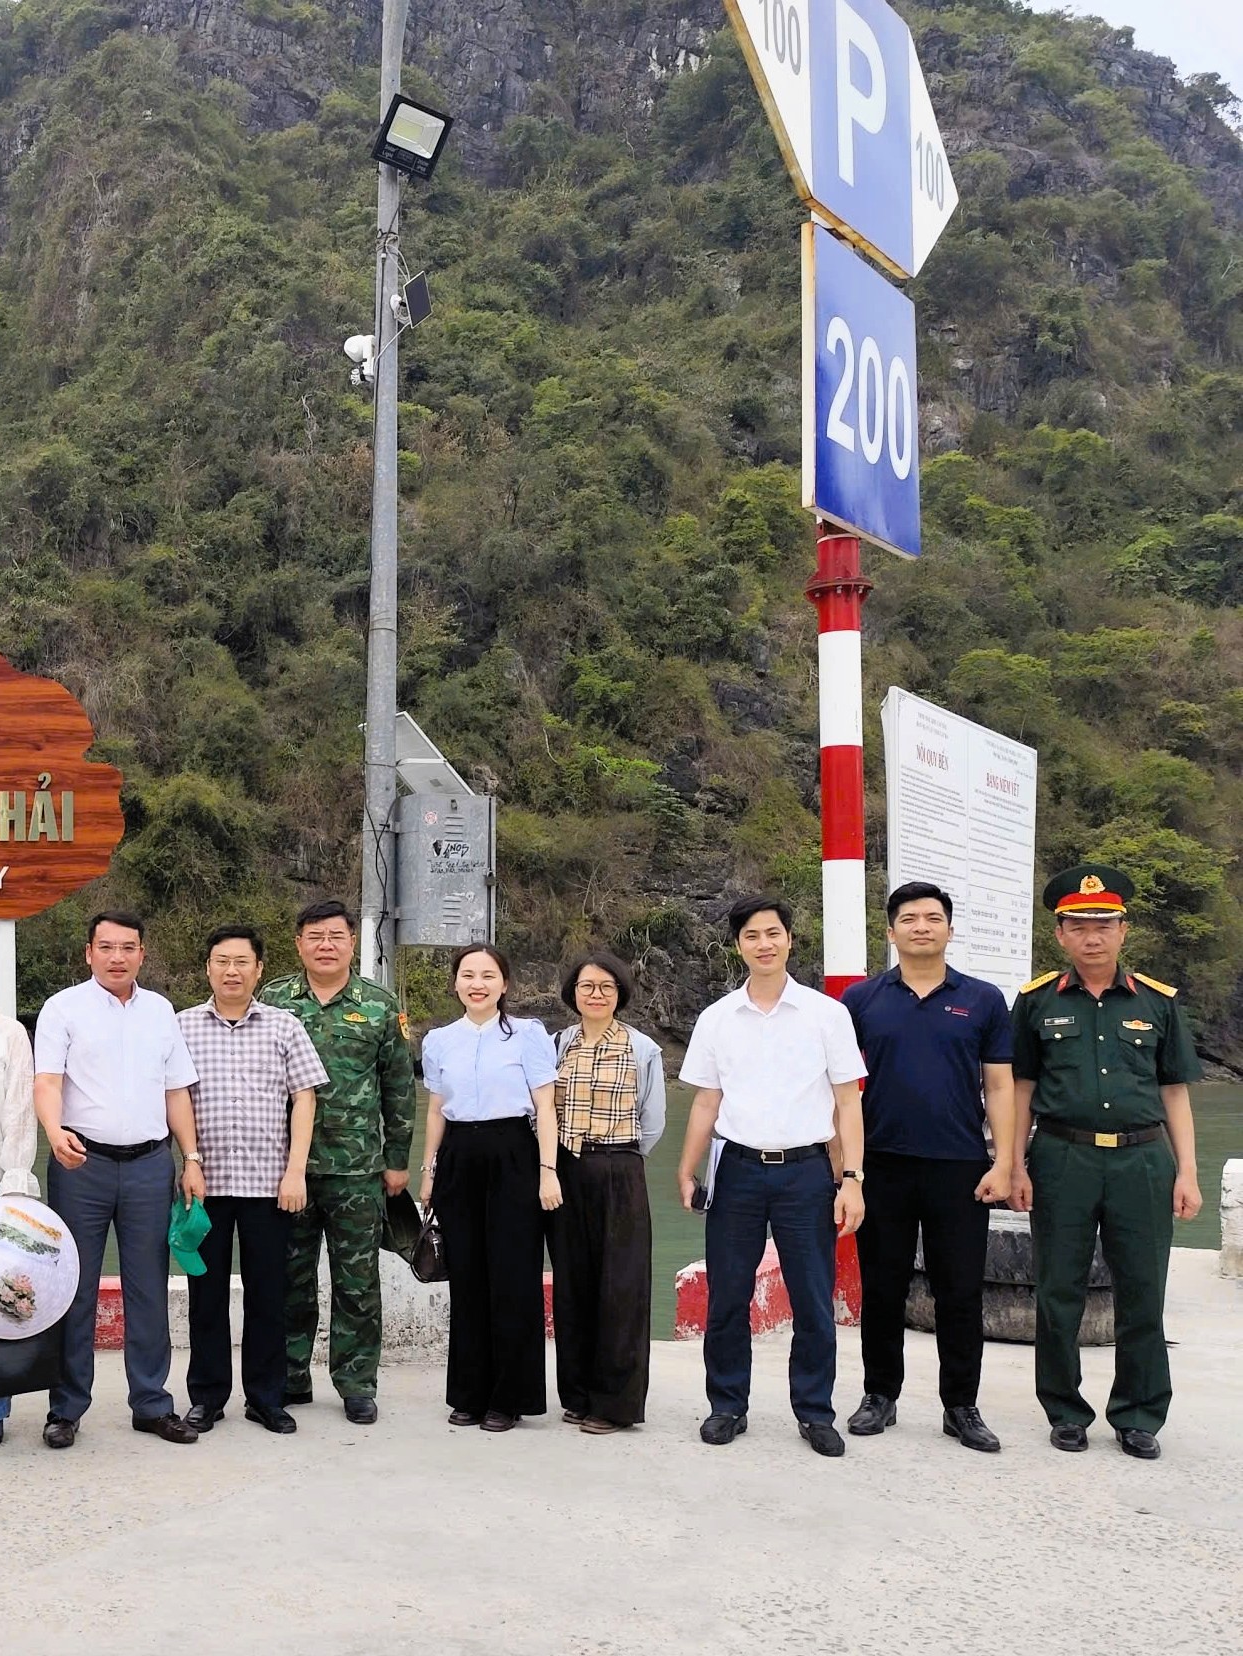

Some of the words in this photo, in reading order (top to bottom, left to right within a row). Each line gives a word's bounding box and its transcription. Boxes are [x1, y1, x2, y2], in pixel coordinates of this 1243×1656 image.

[759, 0, 801, 76] 100
[836, 0, 887, 188] P
[916, 128, 944, 212] 100
[826, 316, 912, 480] 200
